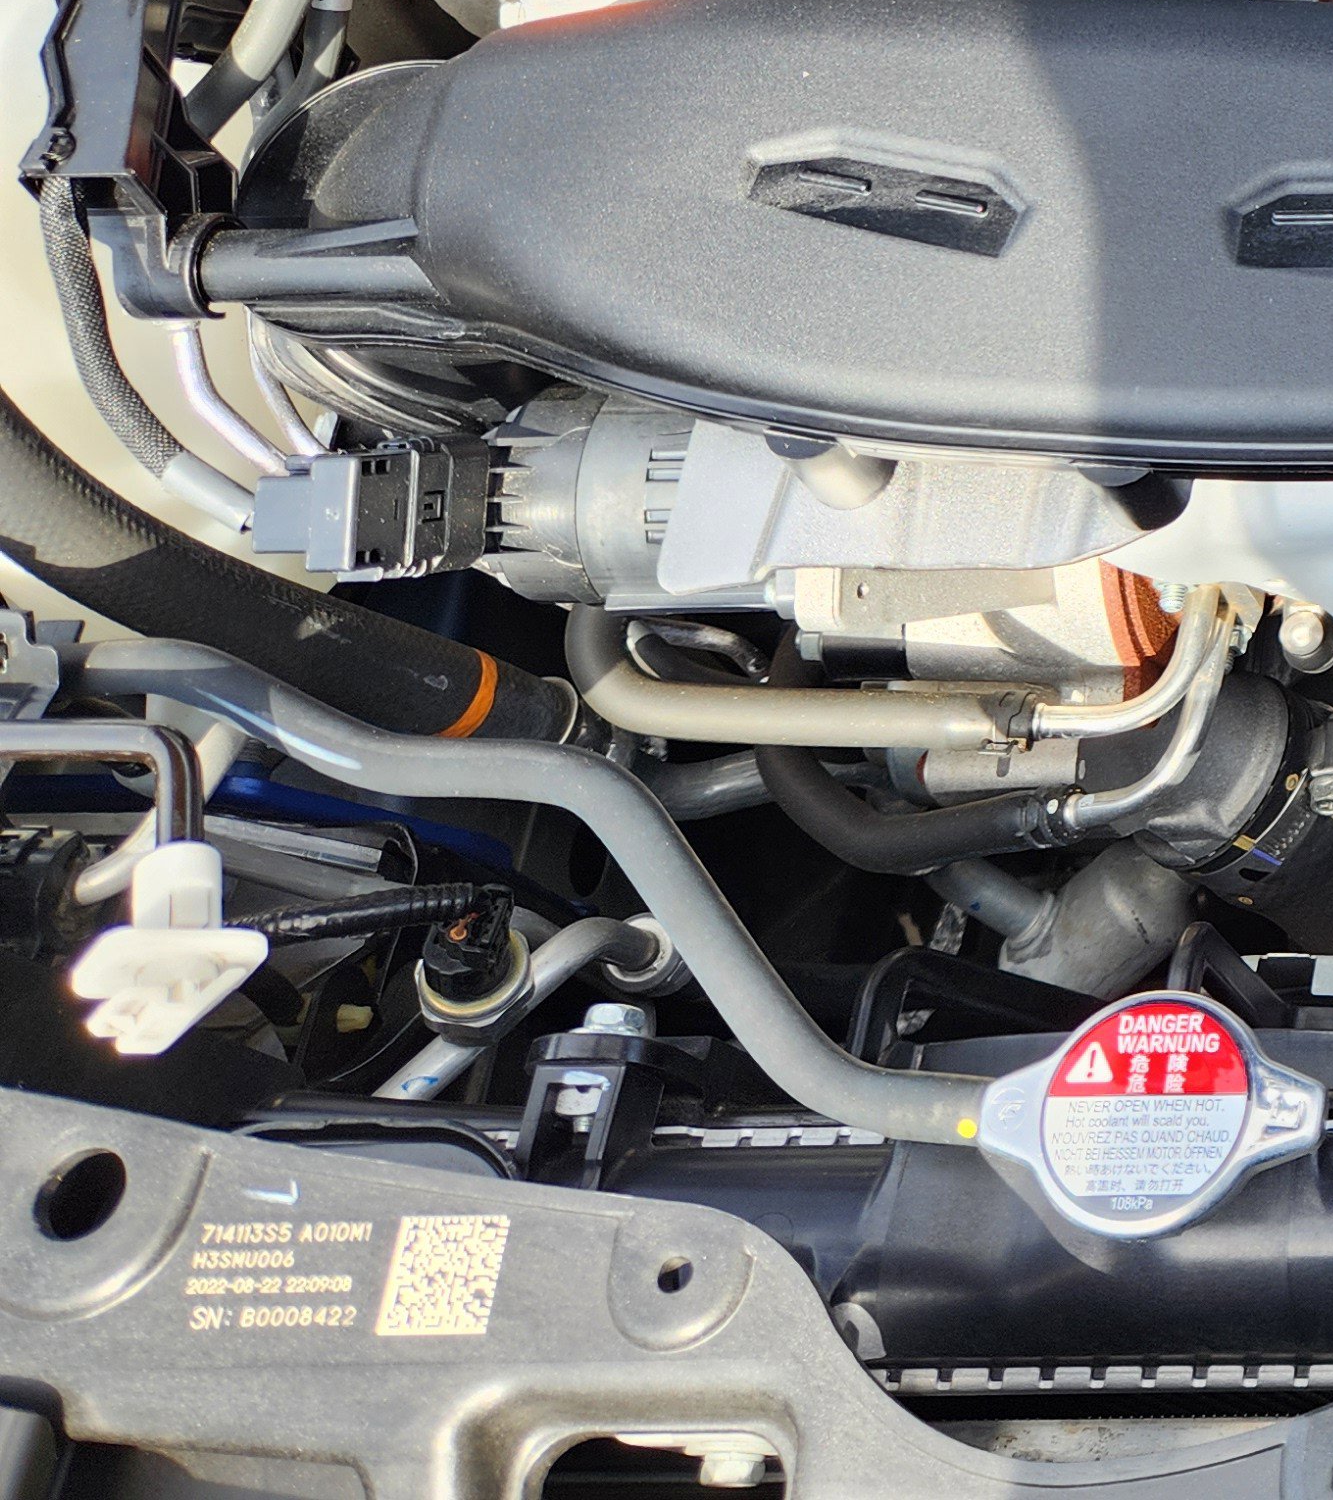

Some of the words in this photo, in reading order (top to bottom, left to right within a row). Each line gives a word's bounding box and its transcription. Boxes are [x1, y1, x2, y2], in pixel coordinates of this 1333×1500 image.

[1119, 1012, 1206, 1034] DANGER
[1117, 1032, 1221, 1054] WARNUNG
[1068, 1100, 1111, 1113] NEVER
[1114, 1099, 1149, 1113] OPEN
[1153, 1099, 1192, 1112] WHEN
[1194, 1099, 1226, 1112] HOT.
[1066, 1116, 1085, 1128] Hot
[1088, 1115, 1129, 1128] coolant
[1132, 1115, 1150, 1128] will
[1152, 1114, 1183, 1128] scald
[1114, 1131, 1139, 1144] PAS
[1141, 1131, 1184, 1144] QUAND
[1147, 1146, 1183, 1160] MOTOR
[1111, 1196, 1154, 1211] 108kPa
[299, 1221, 374, 1243] A010M1
[184, 1276, 283, 1296] 2022-08-22
[188, 1304, 234, 1331] SN:
[239, 1304, 358, 1329] B0008422
